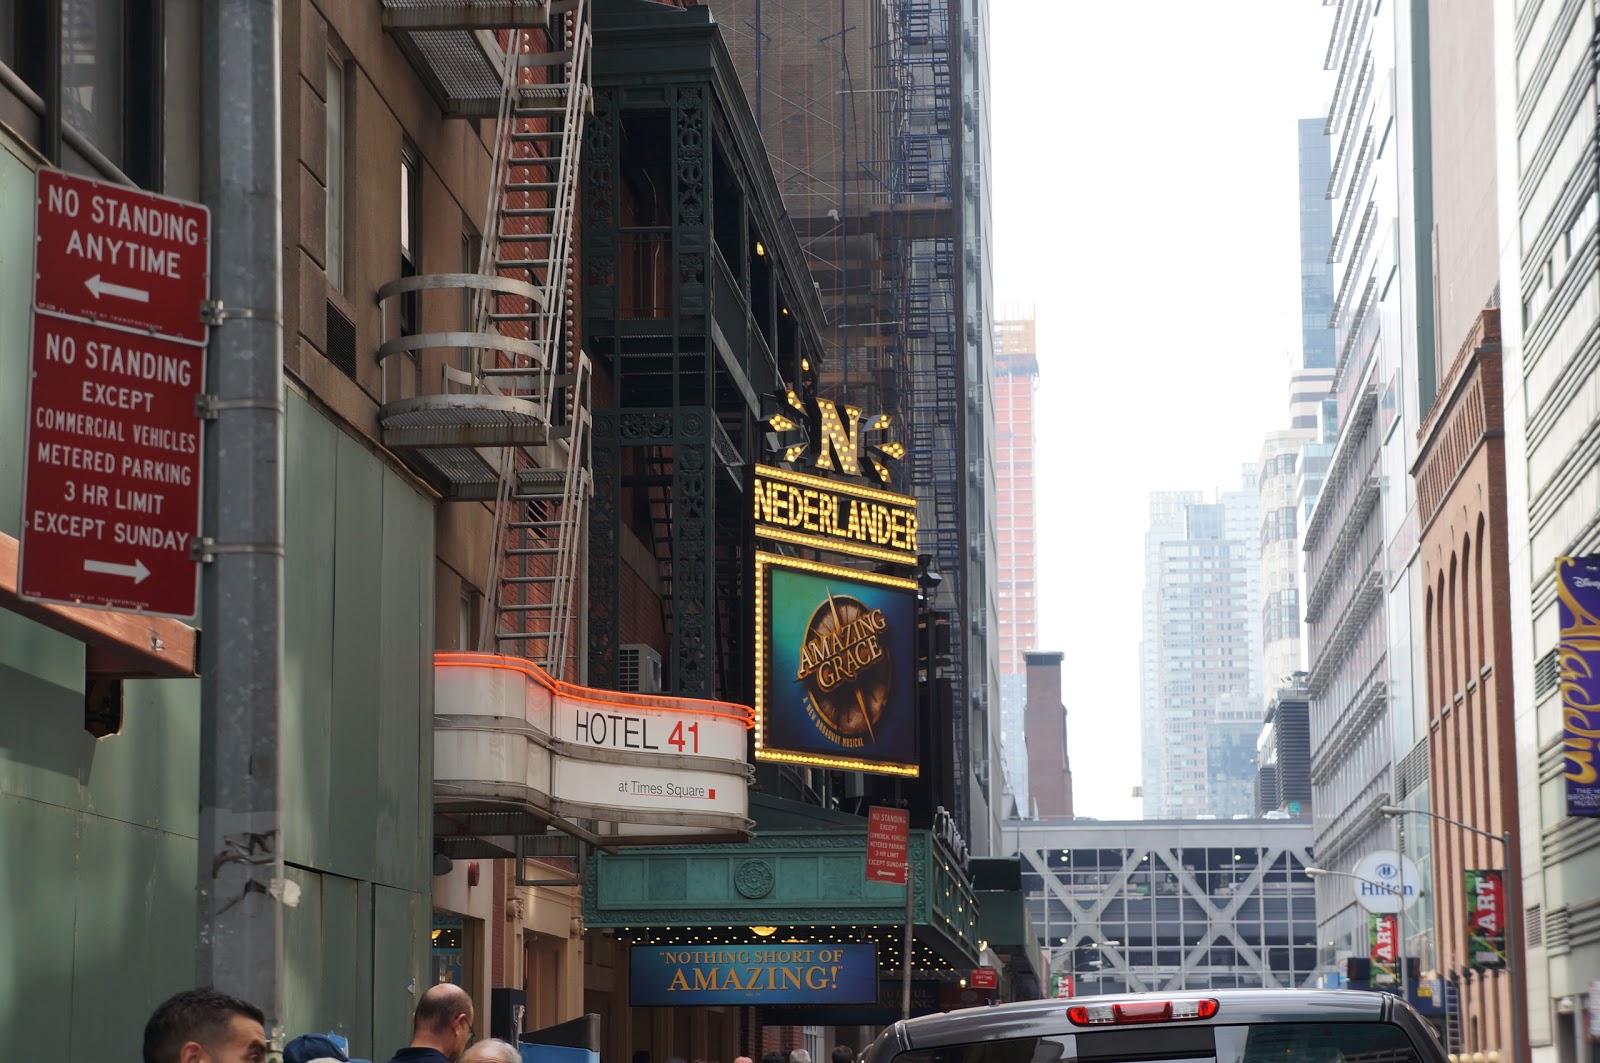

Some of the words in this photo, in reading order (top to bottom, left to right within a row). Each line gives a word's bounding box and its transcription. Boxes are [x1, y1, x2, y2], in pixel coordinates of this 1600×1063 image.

[49, 185, 79, 218] NO
[91, 195, 199, 246] STANDING
[66, 229, 181, 279] ANYTIME
[46, 333, 75, 364] NO
[85, 341, 192, 387] STANDING
[82, 381, 154, 413] EXCEPT
[36, 407, 125, 442] COMMERCIAL
[132, 424, 196, 454] VEHICLES
[815, 397, 863, 476] N
[38, 442, 115, 474] METERED
[122, 456, 192, 486] PARKING
[64, 480, 75, 501] 3
[82, 483, 108, 507] HR
[115, 488, 164, 515] LIMIT
[754, 479, 918, 551] NEDERLANDER
[33, 510, 105, 540] EXCEPT
[114, 522, 189, 552] SUNDAY
[800, 609, 886, 673] AMAZING
[818, 635, 882, 688] GRACE
[576, 710, 658, 750] HOTEL
[668, 721, 699, 754] 41
[842, 737, 864, 747] MUSICAL
[618, 782, 628, 793] at
[631, 781, 662, 795] Times
[666, 783, 704, 799] Square
[872, 813, 880, 821] NO
[881, 814, 906, 824] STANDING
[1475, 876, 1497, 931] ART
[660, 951, 750, 965] "NOTHING
[755, 950, 814, 964] SHORT
[818, 950, 844, 963] OF
[1376, 917, 1392, 960] ART
[667, 965, 843, 991] AMAZING!"
[1058, 977, 1069, 997] RT
